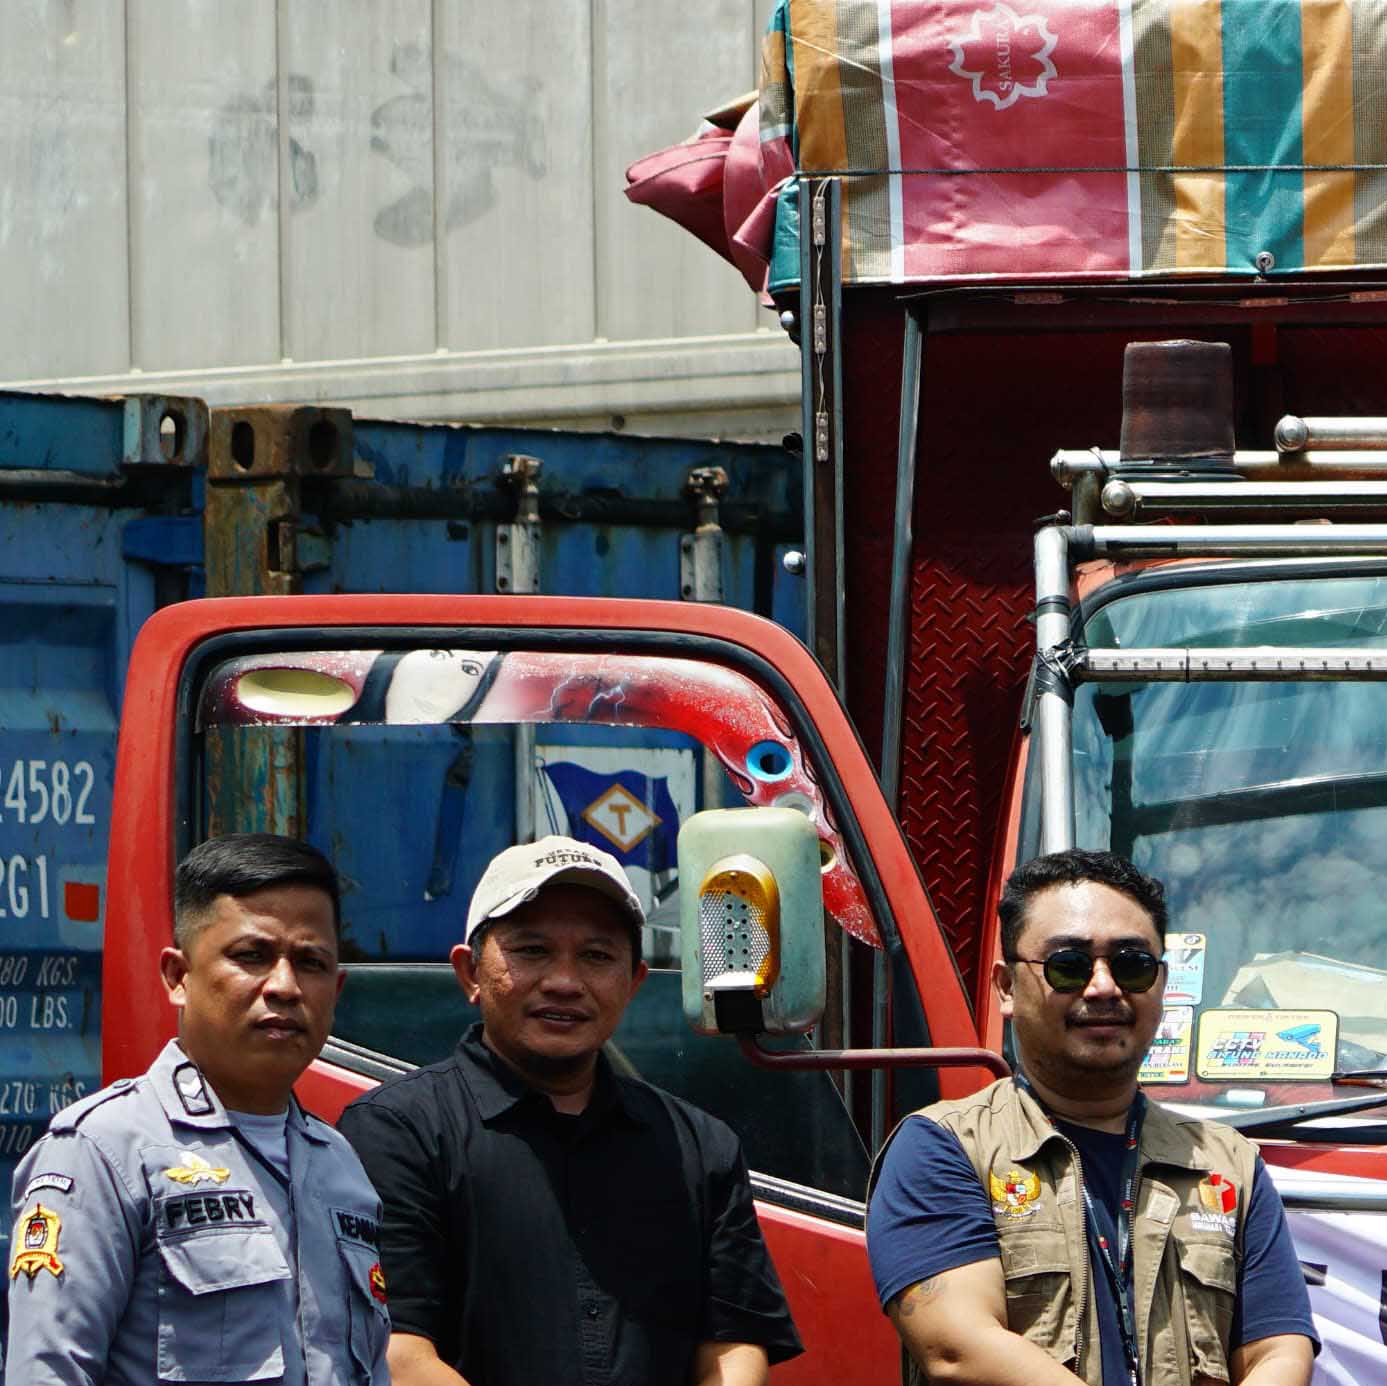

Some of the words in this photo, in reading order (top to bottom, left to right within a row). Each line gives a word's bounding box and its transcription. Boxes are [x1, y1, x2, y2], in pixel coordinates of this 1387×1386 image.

[0, 760, 95, 825] 4582
[607, 803, 632, 836] T
[30, 995, 73, 1029] LBS.
[164, 1194, 256, 1229] FEBRY
